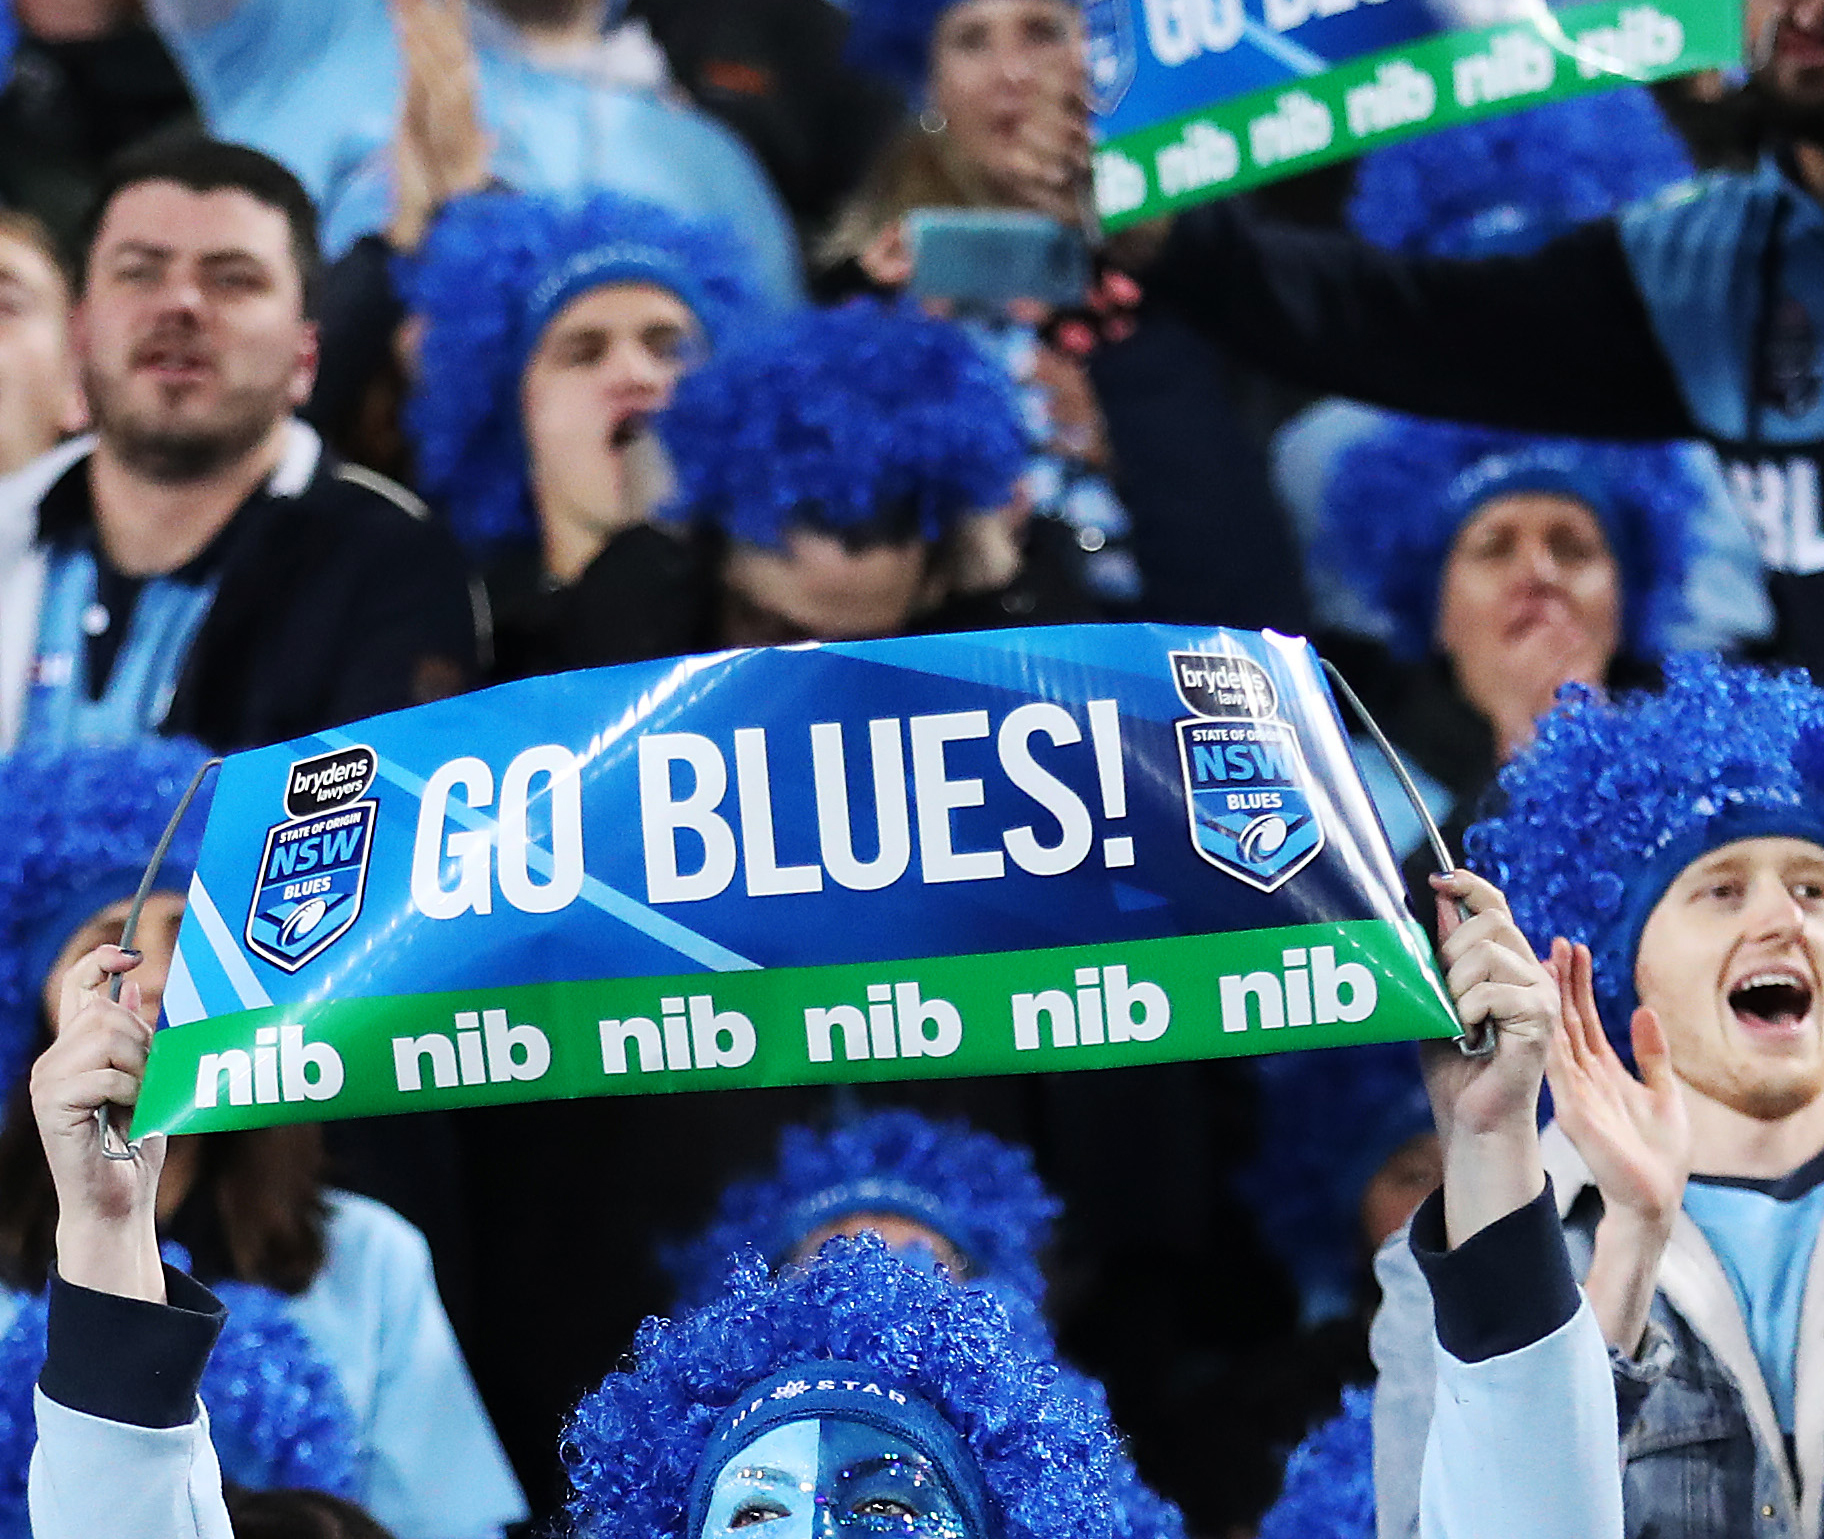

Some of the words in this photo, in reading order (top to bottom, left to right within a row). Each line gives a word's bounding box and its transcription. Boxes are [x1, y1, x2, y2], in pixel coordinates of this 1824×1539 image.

[1156, 120, 1240, 197] nib
[1249, 91, 1334, 167] nib
[1345, 60, 1437, 137] nib
[1453, 31, 1556, 107] nib
[1578, 4, 1684, 79] nib
[1192, 729, 1229, 743] STATE
[1229, 729, 1247, 742] OF
[293, 758, 369, 794] brydens
[1193, 745, 1294, 782] NSW
[316, 779, 363, 803] lawyers
[1227, 792, 1283, 810] BLUES
[410, 743, 586, 920] GO
[638, 699, 1135, 904] BLUES!
[279, 826, 311, 844] STATE
[311, 822, 326, 836] OF
[326, 811, 363, 832] ORIGIN
[268, 826, 363, 880] NSW
[283, 876, 333, 901] BLUES
[195, 1024, 345, 1109] nib
[391, 1008, 552, 1092] nib
[599, 995, 757, 1075] nib
[804, 981, 963, 1062] nib
[1010, 964, 1171, 1052] nib
[1218, 945, 1378, 1034] nib
[816, 1379, 907, 1405] STAR
